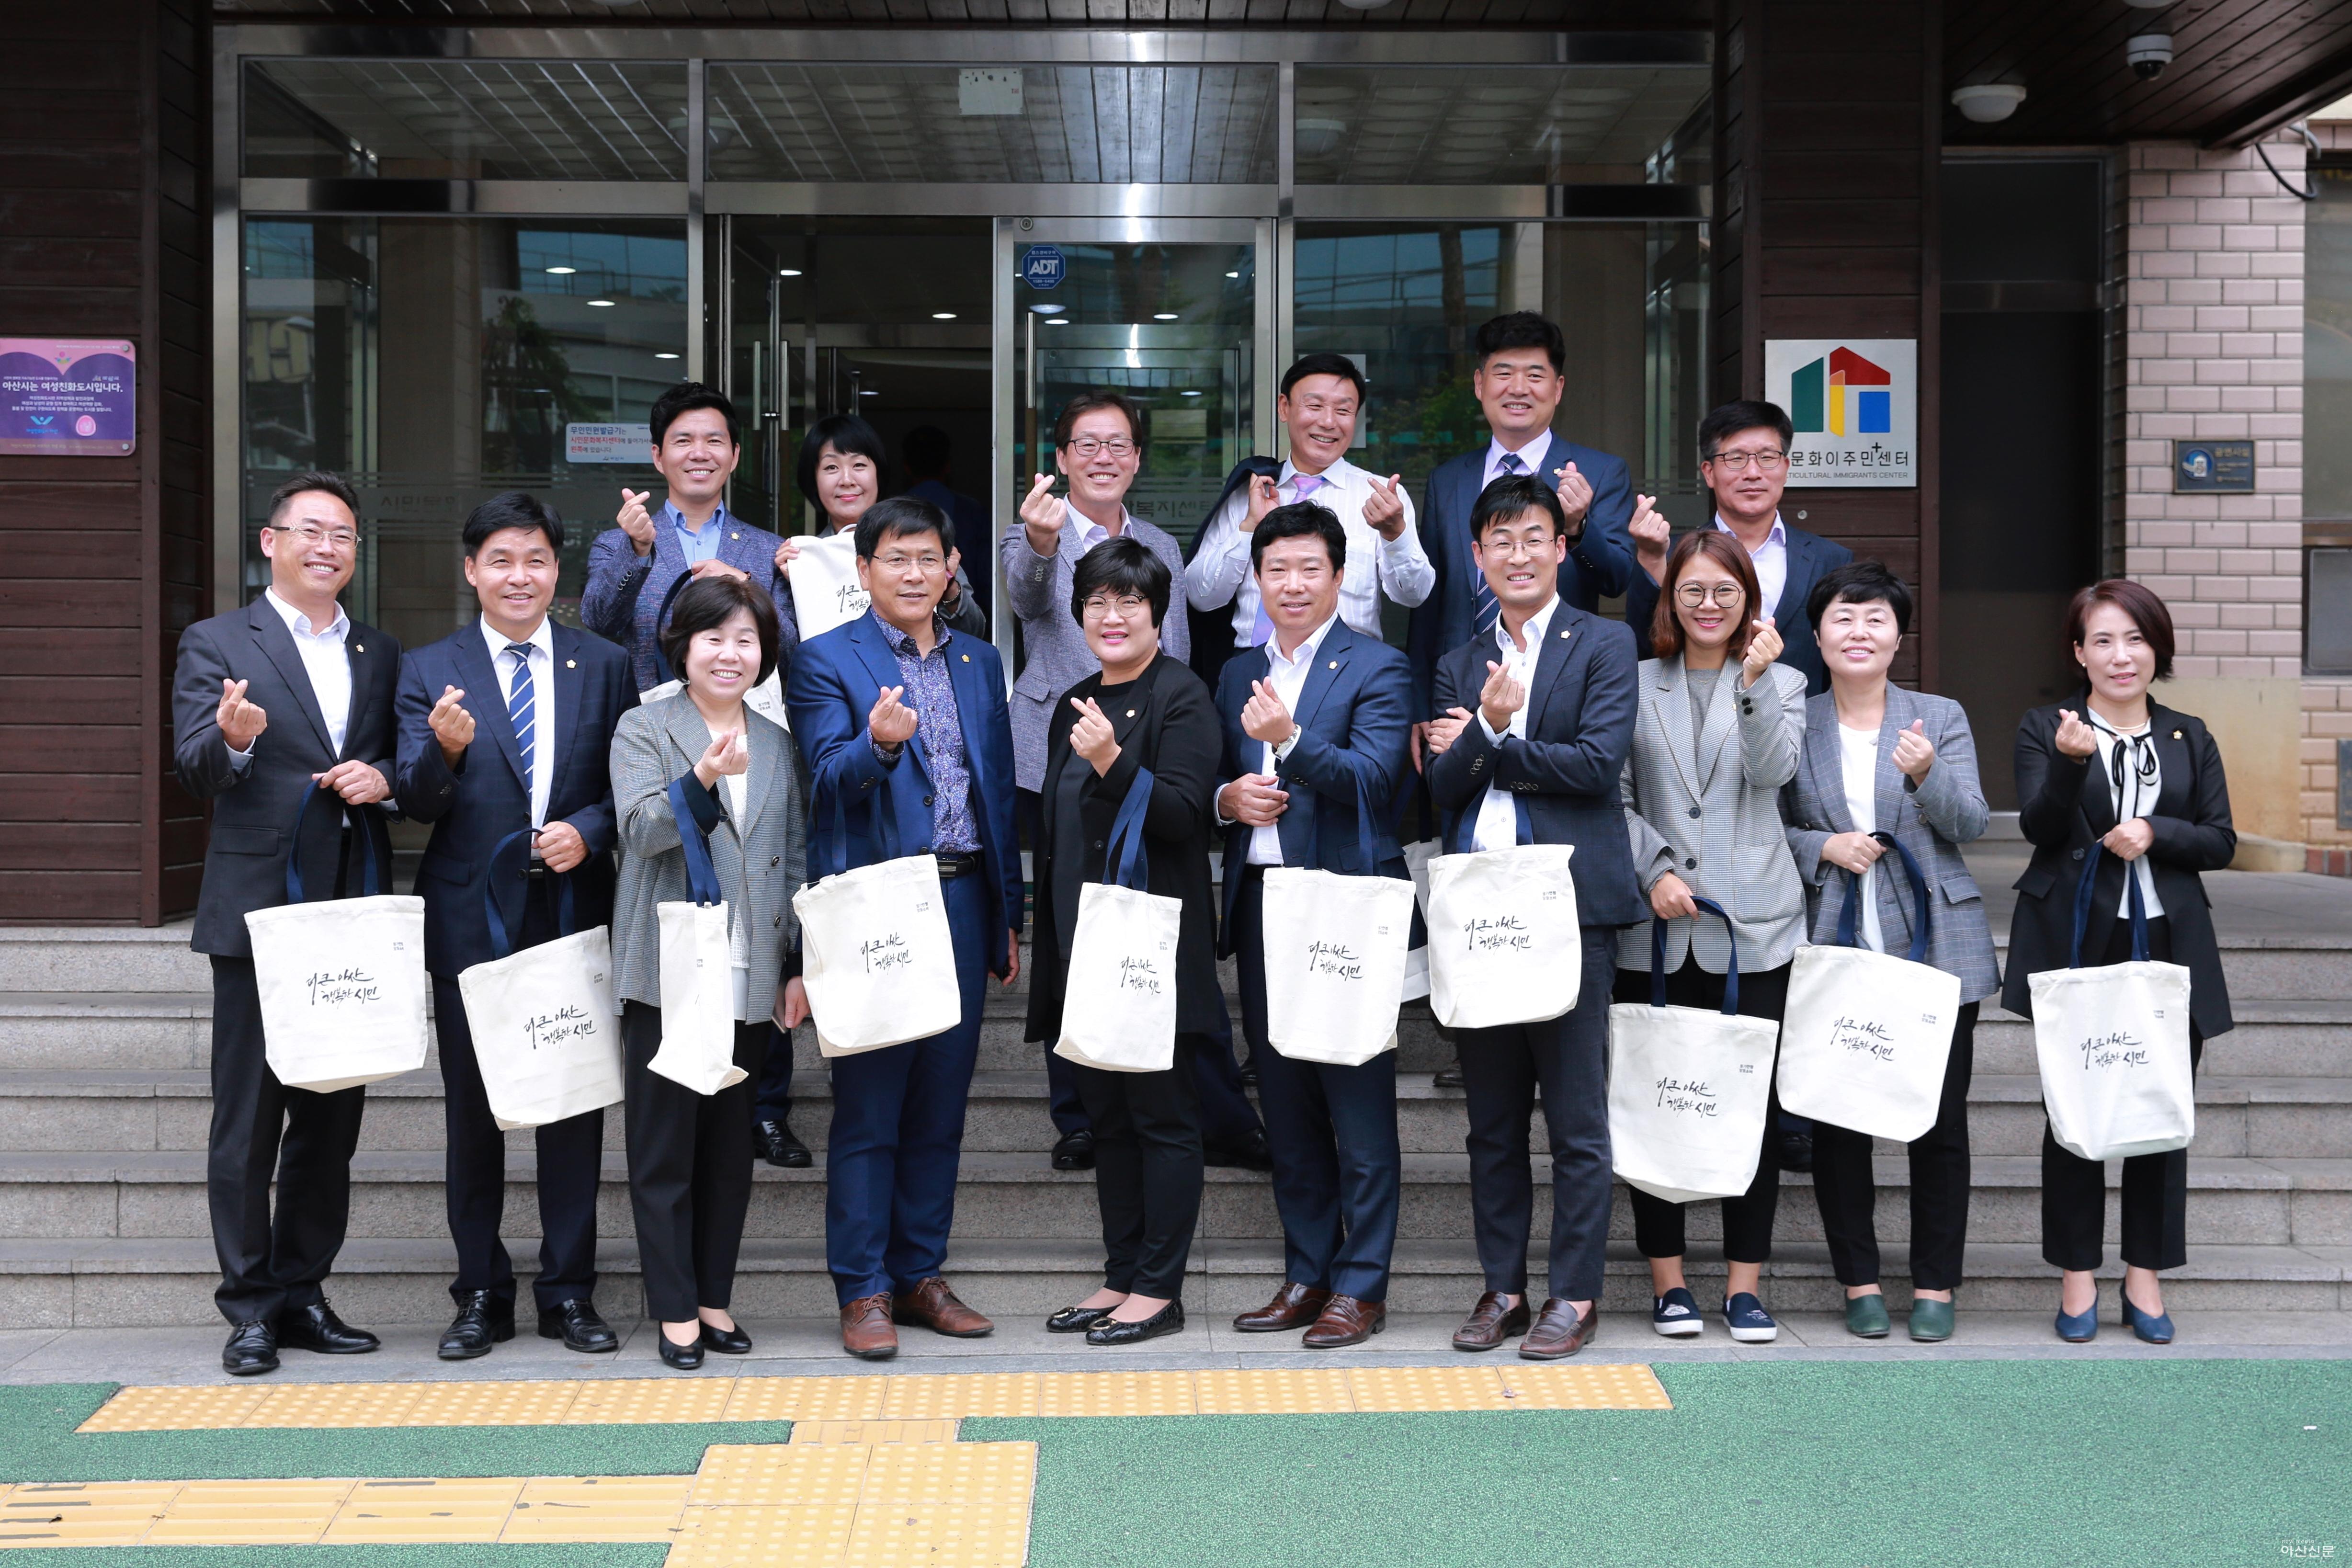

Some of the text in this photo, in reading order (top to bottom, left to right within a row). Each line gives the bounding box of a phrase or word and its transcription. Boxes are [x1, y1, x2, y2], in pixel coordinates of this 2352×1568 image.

[1030, 260, 1058, 274] ADT
[2, 381, 123, 393] 아산시는 여성친화도시입니다.
[571, 427, 626, 435] 무인민원발급기는
